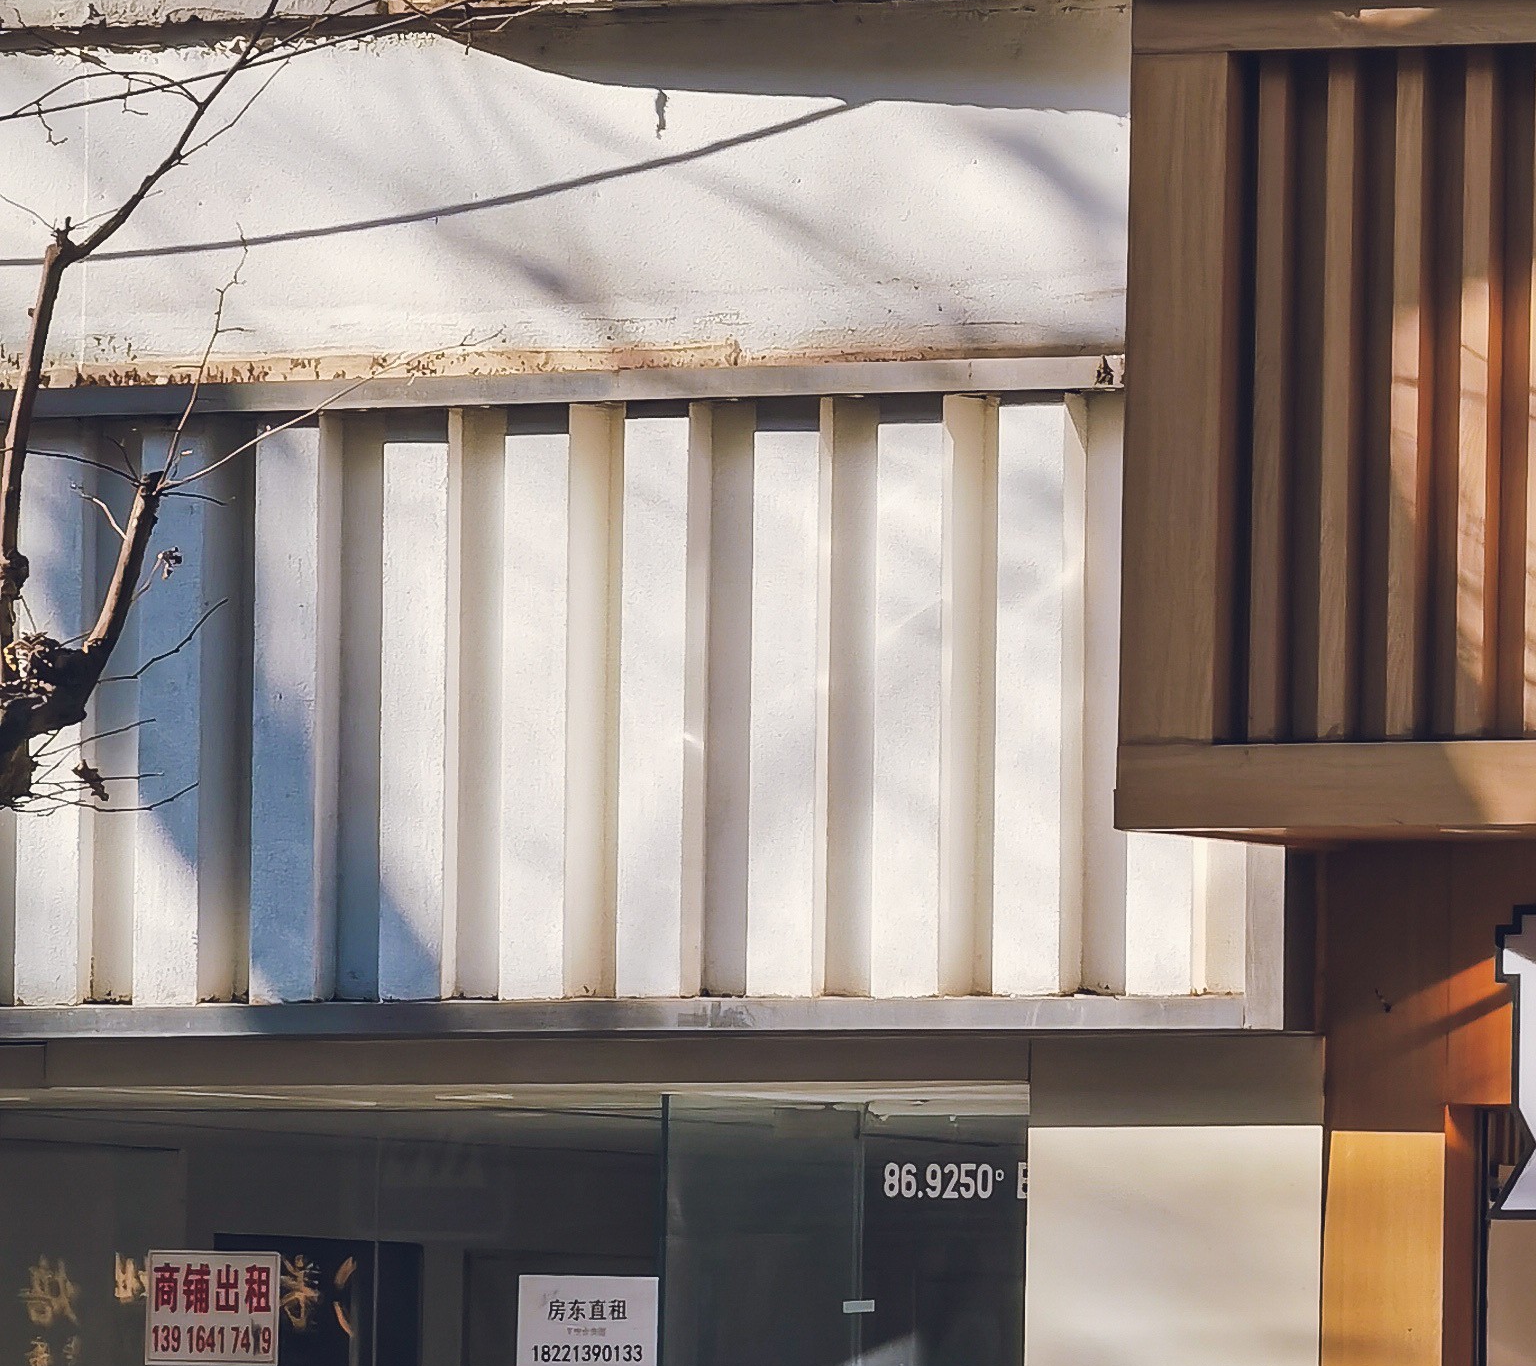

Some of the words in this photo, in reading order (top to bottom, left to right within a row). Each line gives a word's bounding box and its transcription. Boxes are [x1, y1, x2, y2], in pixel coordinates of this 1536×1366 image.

[154, 1263, 271, 1314] 商铺出租
[548, 1299, 627, 1321] 房东直租
[152, 1325, 181, 1353] 139
[187, 1326, 224, 1354] 1641
[532, 1345, 642, 1362] 18221390133
